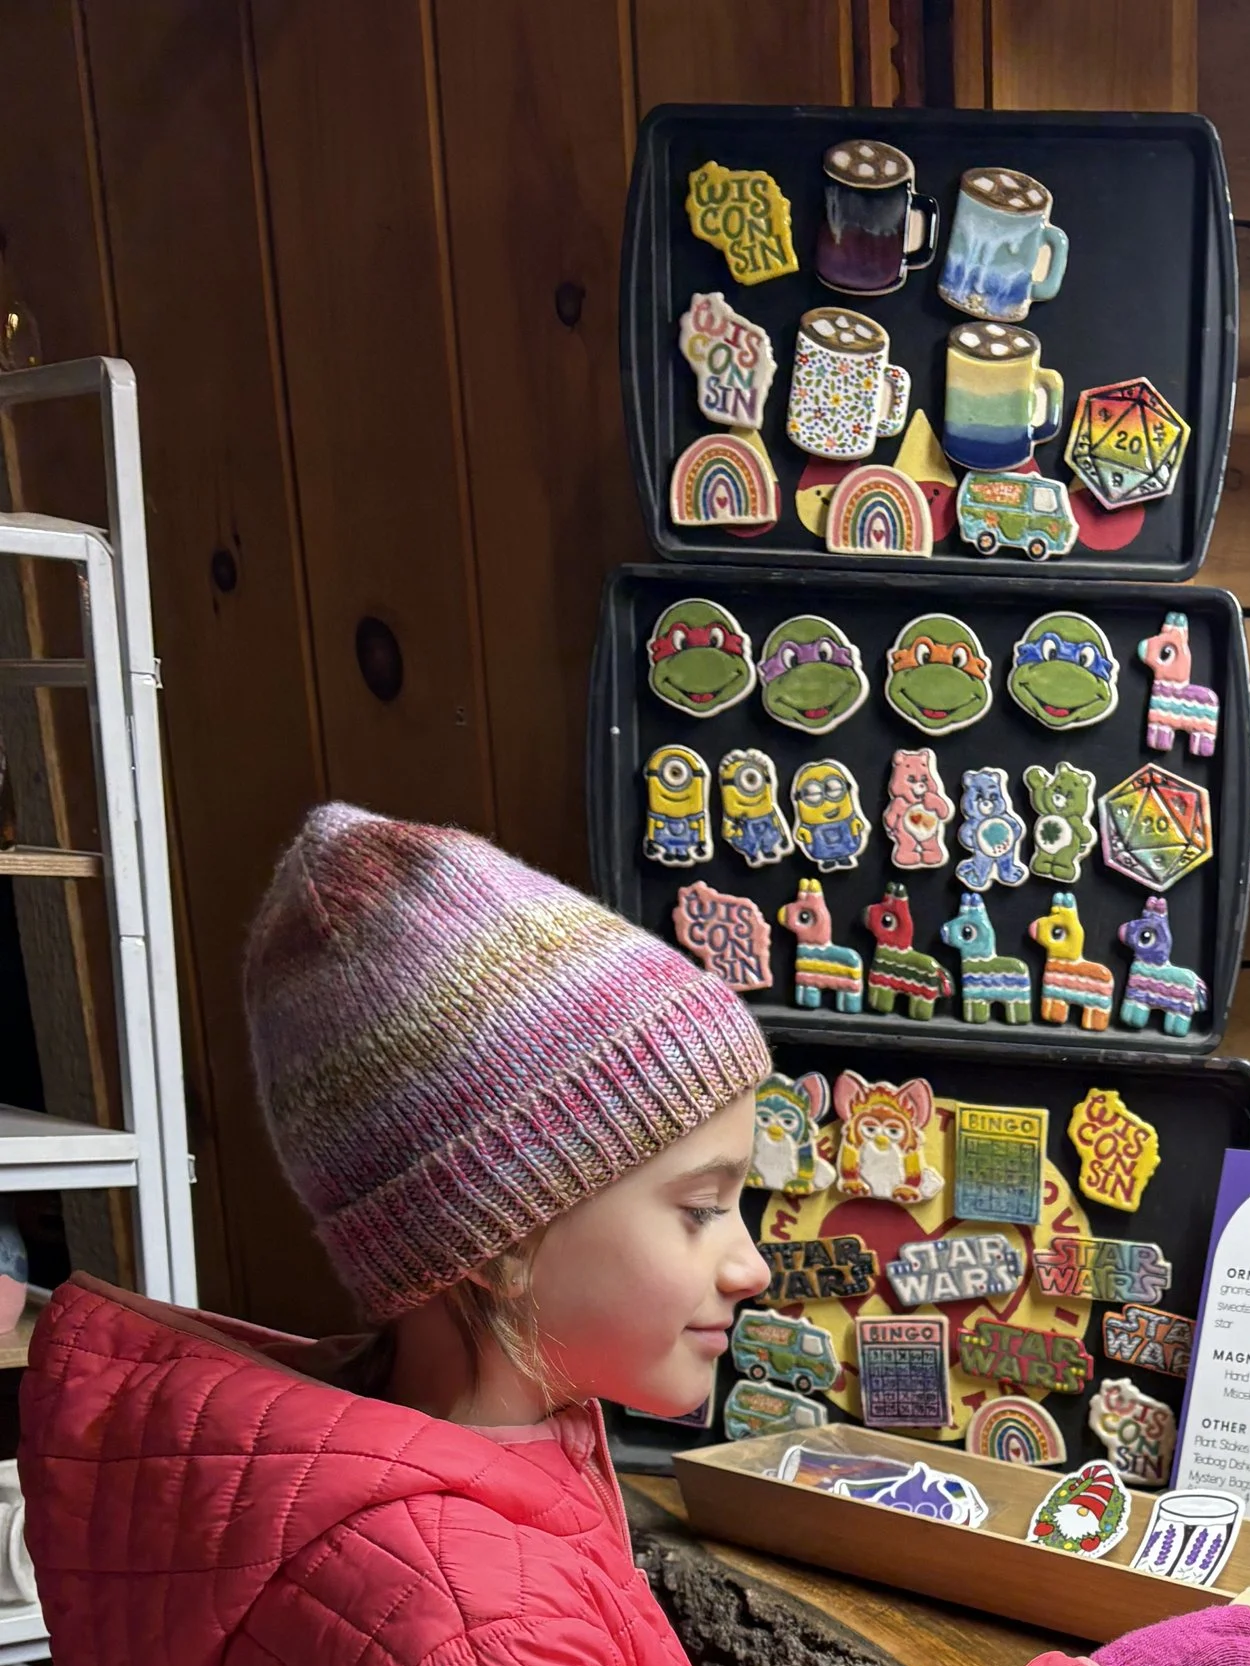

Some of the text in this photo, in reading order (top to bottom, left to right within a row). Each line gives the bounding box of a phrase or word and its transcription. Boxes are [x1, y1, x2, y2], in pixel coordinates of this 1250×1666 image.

[695, 172, 769, 219] WIS
[700, 204, 773, 240] CON
[729, 235, 788, 274] SIN
[691, 300, 762, 369] WIS
[688, 333, 754, 390] CON
[705, 375, 758, 420] SIN
[1114, 431, 1142, 454] 20
[685, 890, 754, 939] WIS
[689, 922, 754, 959] CON
[712, 954, 764, 984] SIN
[968, 1114, 1034, 1134] BINGO
[1086, 1094, 1151, 1160] WIS
[1077, 1121, 1138, 1177] CON
[1086, 1159, 1138, 1202] SIN
[890, 1237, 1019, 1274] STAR
[1034, 1238, 1167, 1275] STAR
[894, 1266, 1020, 1303] WARS
[1036, 1265, 1167, 1305] WARS
[869, 1325, 934, 1341] BINGO
[1106, 1307, 1192, 1345] STA
[1214, 1317, 1234, 1329] star
[960, 1322, 1090, 1366] STAR
[960, 1347, 1088, 1392] WARS
[1224, 1370, 1250, 1383] Hand
[1104, 1386, 1168, 1440] WIS
[1201, 1418, 1247, 1434] OTHER
[1100, 1412, 1161, 1457] CON
[1194, 1435, 1217, 1449] Plant
[1219, 1439, 1250, 1454] Stakes
[1116, 1446, 1164, 1480] SIN
[1188, 1470, 1226, 1488] Mystery
[1193, 1452, 1227, 1470] Teabag
